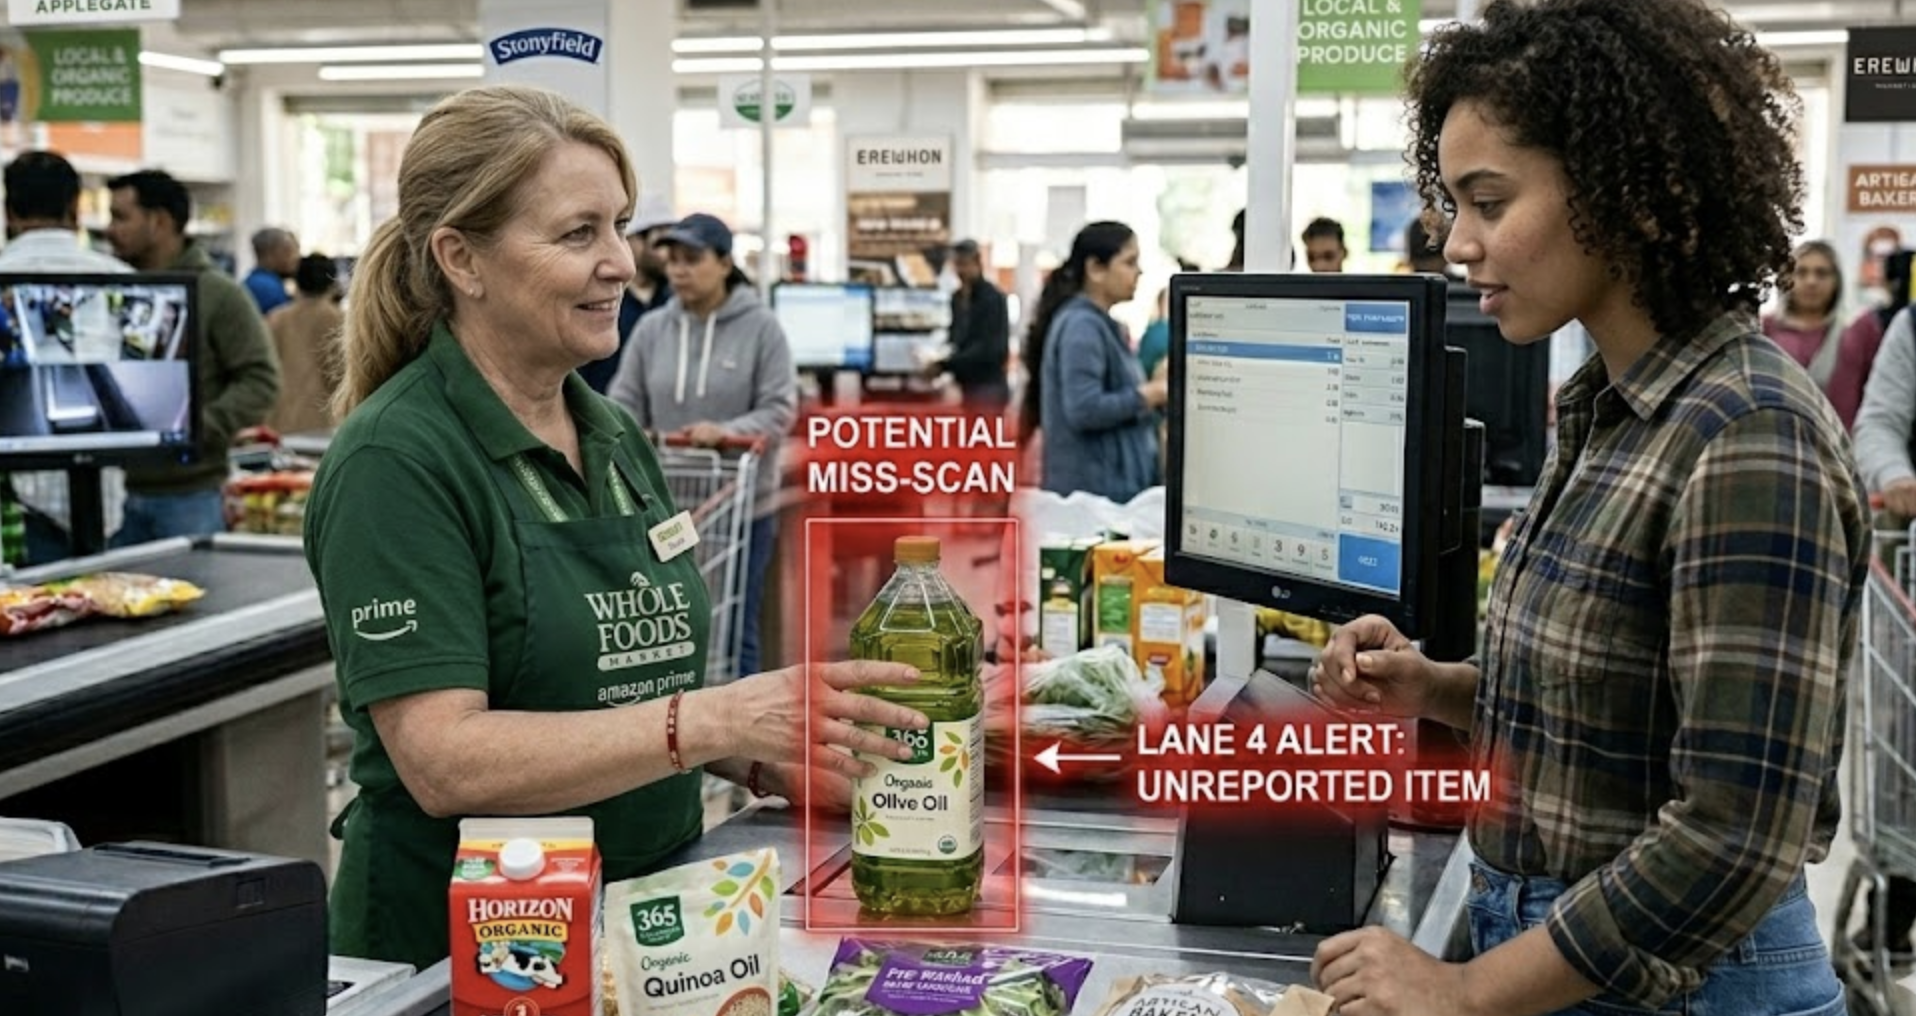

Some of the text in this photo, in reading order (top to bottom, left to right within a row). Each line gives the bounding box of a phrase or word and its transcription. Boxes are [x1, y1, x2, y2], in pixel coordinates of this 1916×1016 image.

[36, 0, 152, 14] APPLEGATE
[1302, 0, 1401, 16] LOCAL &
[1299, 20, 1407, 39] ORGANIC
[497, 31, 596, 59] Stonyfield
[1299, 44, 1406, 64] PRODUCE
[54, 47, 111, 64] LOCAL
[1854, 57, 1916, 74] EREW
[52, 67, 130, 85] ORGANIC
[52, 87, 131, 105] PRODUCE
[584, 582, 691, 620] WHOLE
[352, 597, 417, 628] prime
[597, 612, 692, 653] FOODS
[598, 670, 696, 701] amazon prime
[468, 897, 574, 923] HORIZON
[637, 904, 677, 931] 365
[479, 923, 563, 938] ORGANIC
[644, 953, 760, 998] Quinoa Oil
